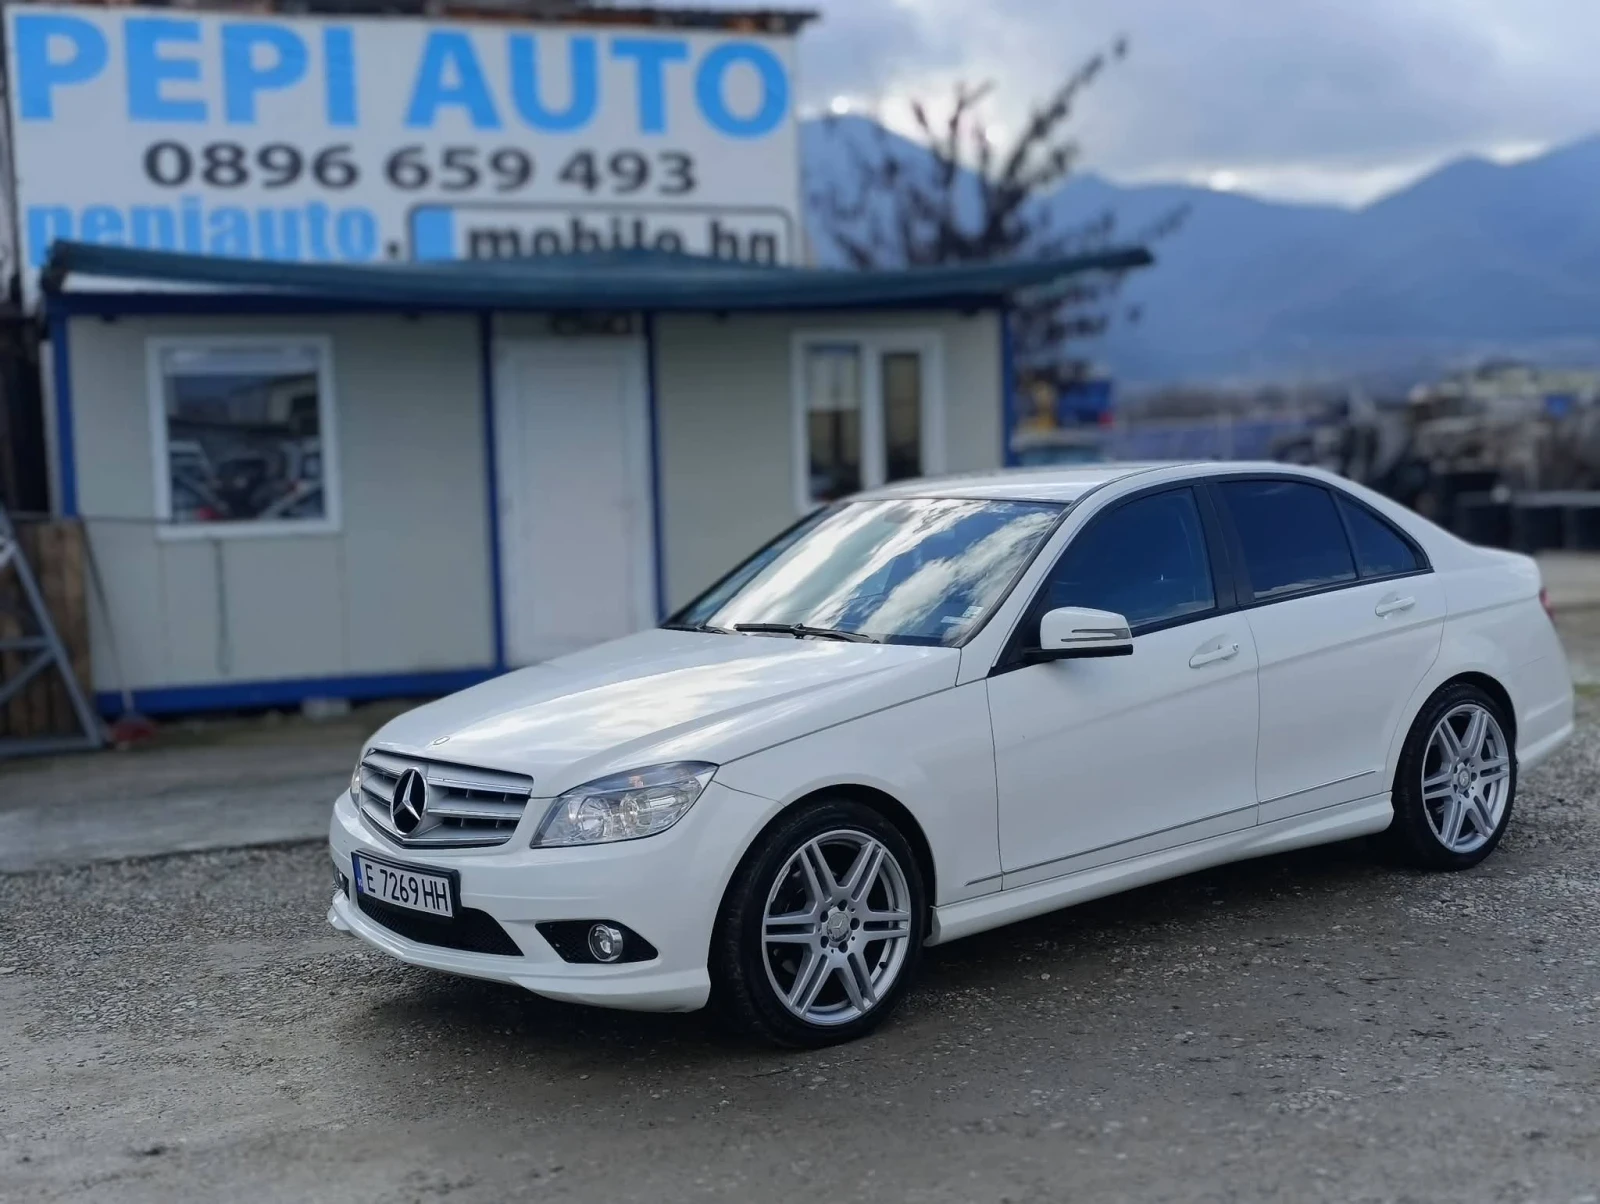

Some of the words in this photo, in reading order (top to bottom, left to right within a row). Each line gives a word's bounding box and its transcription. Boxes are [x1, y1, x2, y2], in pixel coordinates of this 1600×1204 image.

[14, 13, 359, 126] PEPI
[405, 29, 790, 138] AUTO
[144, 140, 361, 189] 0896
[384, 146, 535, 192] 659
[557, 150, 697, 195] 493
[364, 863, 376, 894] E
[379, 869, 419, 906] 7269
[421, 878, 449, 912] HH
